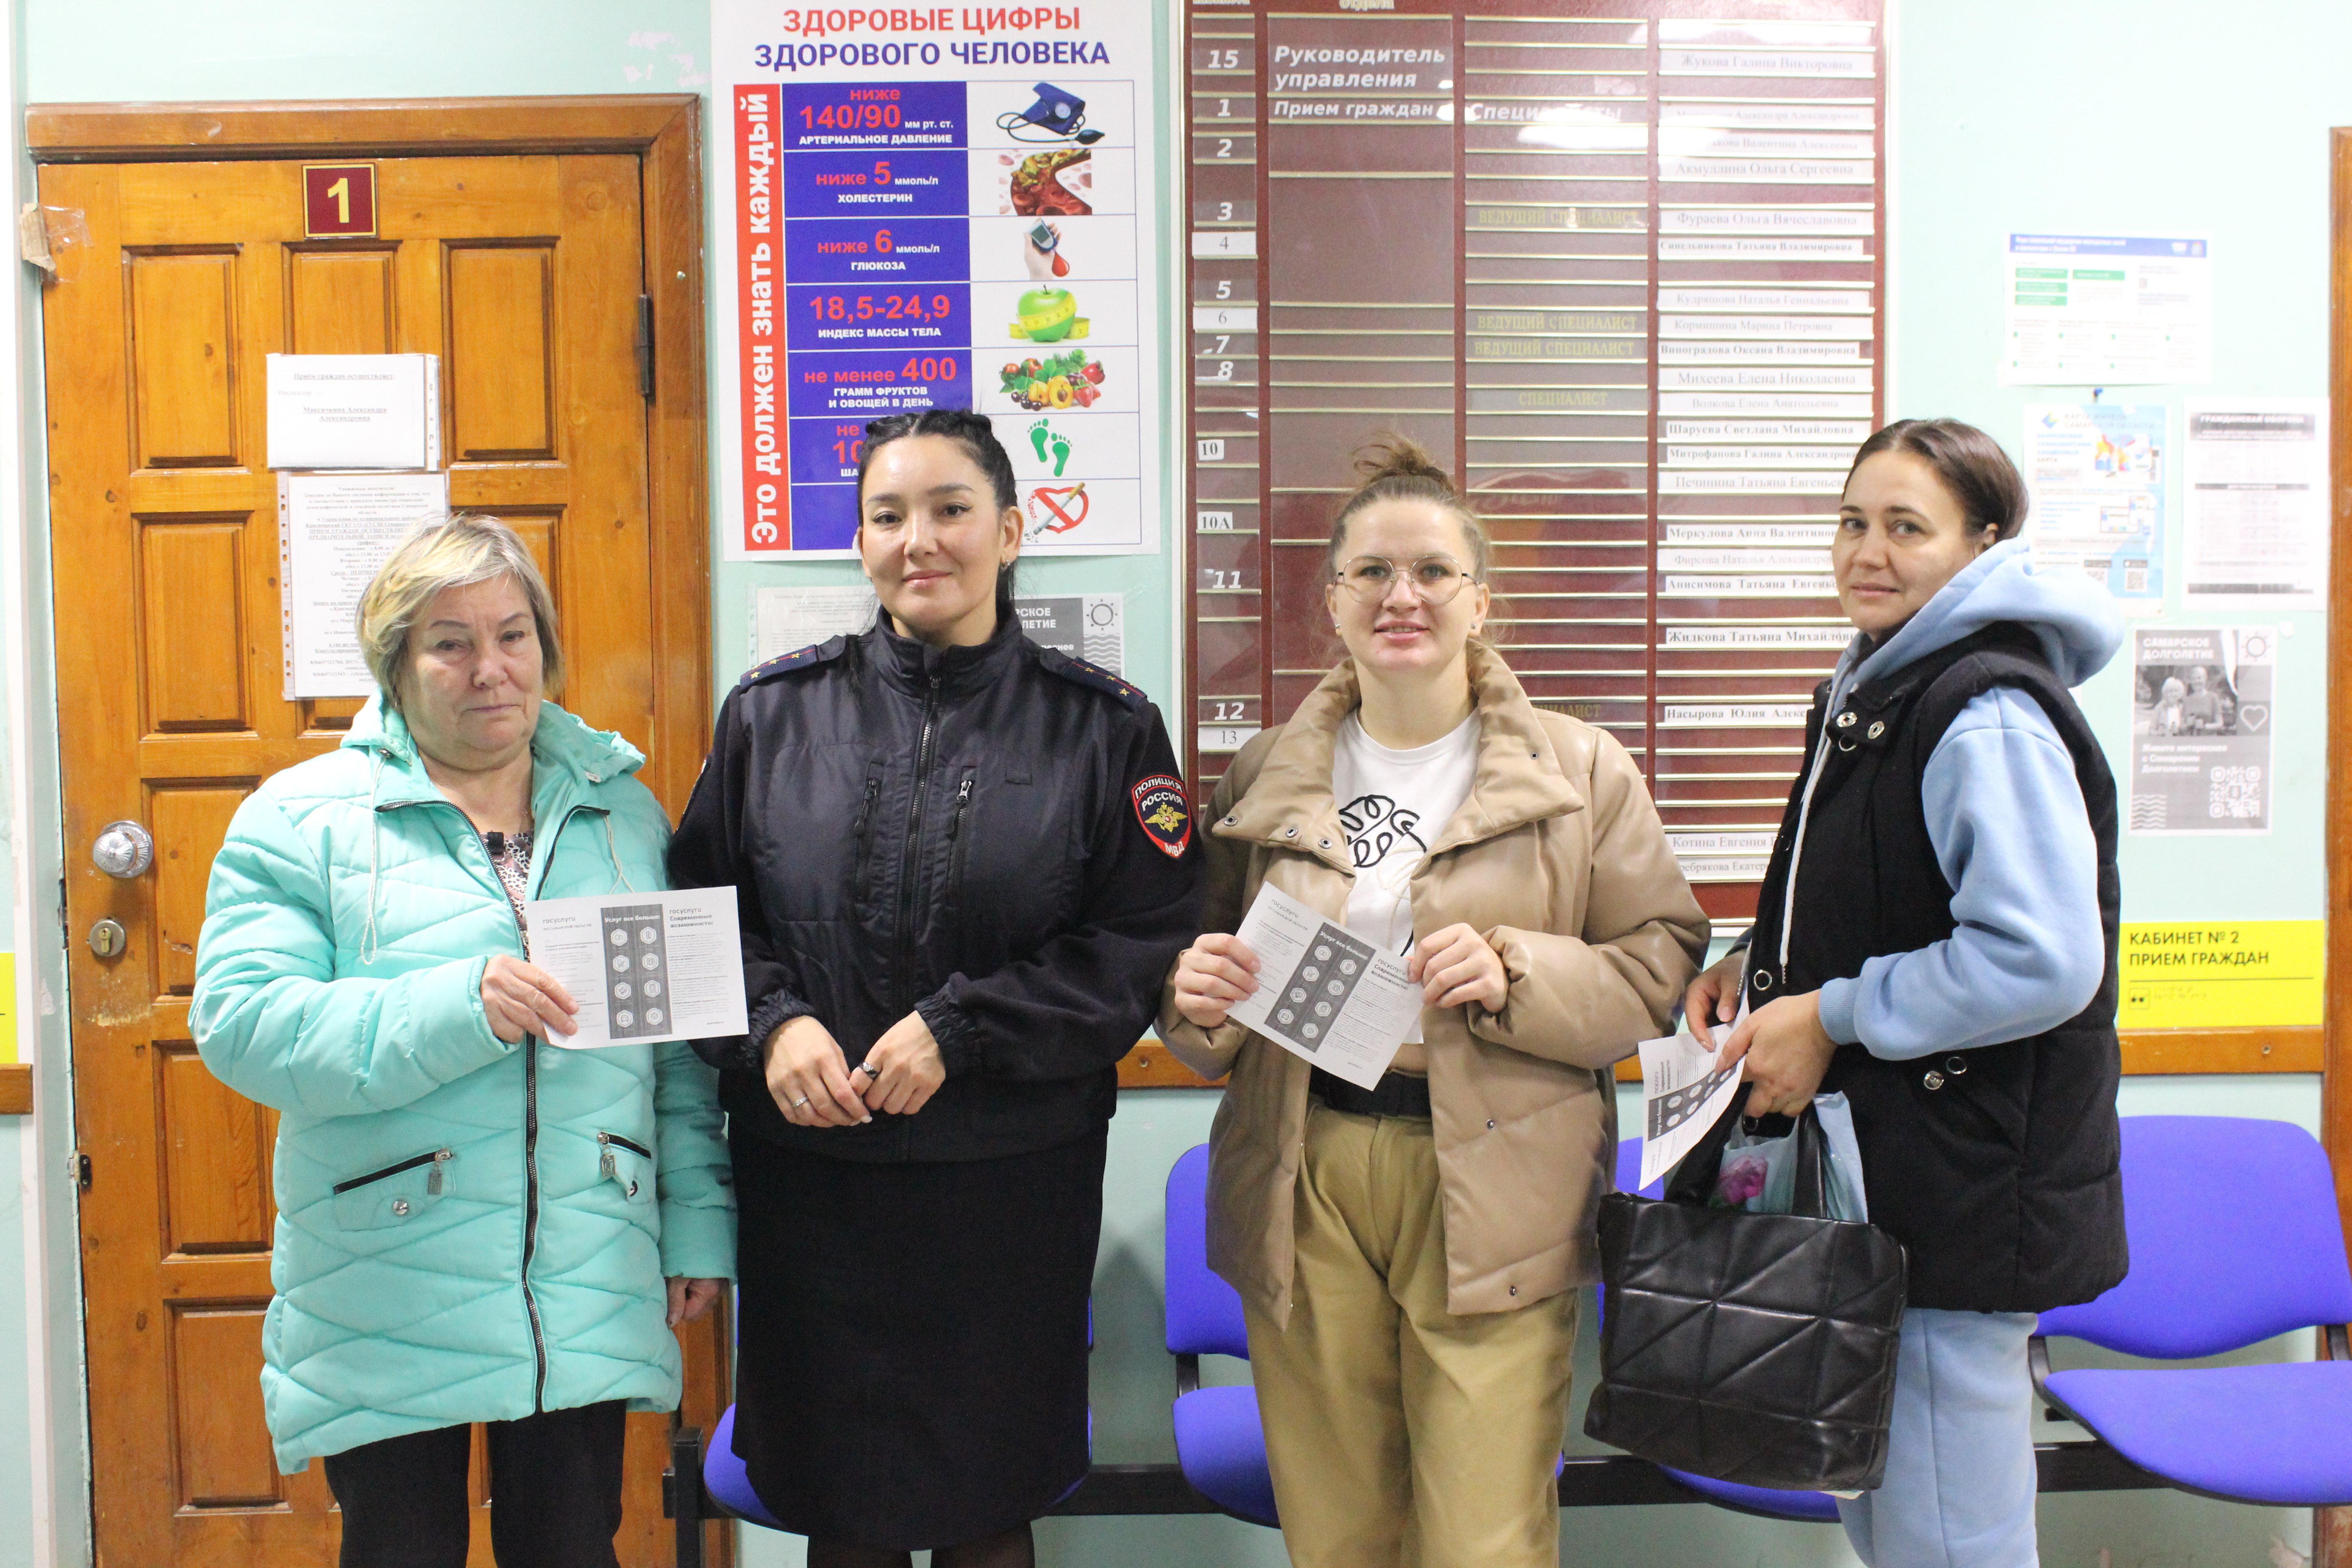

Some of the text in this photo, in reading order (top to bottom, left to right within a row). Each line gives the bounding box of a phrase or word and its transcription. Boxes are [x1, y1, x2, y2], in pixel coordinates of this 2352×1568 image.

[784, 7, 1081, 36] ЗДОРОВЫЕ ЦИФРЫ
[755, 42, 1110, 71] ЗДОРОВОГО ЧЕЛОВЕКА
[1208, 45, 1446, 69] 15 Руководитель
[1681, 54, 1852, 72] Жукова Галина Викторовна
[1274, 72, 1417, 91] управления
[850, 89, 901, 101] ниже
[1217, 98, 1433, 118] 1 Прием граждан
[799, 104, 901, 129] 140/90
[922, 120, 937, 130] рт.
[940, 120, 954, 128] ст.
[799, 134, 952, 146] АРТЕРИАЛЬНОЕ ДАВЛЕНИЕ
[1217, 138, 1232, 157] 2
[1743, 137, 1796, 150] Валентина
[816, 161, 939, 186] ниже 5 ммоль/л
[1676, 162, 1853, 177] Акмуллина Ольга Сергеевна
[327, 177, 350, 223] 1
[838, 193, 913, 203] ХОЛЕСТЕРИН
[1217, 201, 1233, 222] 3
[1479, 209, 1546, 225] ВЕДУЩИЙ
[1733, 213, 1770, 228] Ольга
[1773, 213, 1857, 228] Вячеславовна
[817, 229, 940, 254] ниже 6 ммоль/л
[1219, 236, 1229, 250] 4
[1736, 240, 1776, 252] Татьяна
[851, 261, 906, 271] ГЛЮКОЗА
[1216, 280, 1231, 299] 5
[1739, 294, 1781, 306] Наталья
[809, 295, 950, 324] 18,5-24,9
[740, 93, 781, 544] Это должен знать каждый
[1218, 311, 1227, 324] 6
[1478, 315, 1638, 332] ВЕДУЩИЙ СПЕЦИАЛИСТ
[818, 328, 941, 339] ИНДЕКС МАССЫ ТЕЛА
[1740, 320, 1780, 333] Марина
[1783, 320, 1833, 334] Петровна
[1215, 335, 1230, 354] 7
[1475, 341, 1634, 358] ВЕДУЩИЙ СПЕЦИАЛИСТ
[1661, 344, 1856, 358] Виноградова Оксана Владимировна
[804, 358, 956, 383] не менее 400
[1217, 361, 1234, 380] 8
[1678, 372, 1856, 385] Михеева Елена Николаевна
[833, 385, 927, 396] ГРАММ ФРУКТОВ
[829, 397, 933, 410] И ОВОЩЕЙ В ДЕНЬ
[1519, 392, 1608, 407] СПЕЦИАЛИСТ
[1692, 397, 1839, 411] Волкова Елена Анатольевна
[837, 425, 860, 436] не
[1724, 424, 1779, 436] Светлана
[1782, 424, 1854, 436] Михайловна
[1201, 441, 1219, 456] 10
[1670, 448, 1782, 462] Митрофанова Галина
[1738, 476, 1786, 489] Татьяна
[1669, 527, 1734, 541] Меркулова
[1736, 527, 1766, 539] Анна
[1674, 553, 1764, 568] Фирсова Наталья
[1212, 570, 1242, 589] 11
[1667, 578, 1785, 590] Анисимова Татьяна
[1022, 619, 1056, 629] ЛЕТИЕ
[1668, 631, 1782, 645] Жидкова Татьяна
[2143, 637, 2210, 647] САМАРСКОЕ
[2143, 649, 2214, 661] ДОЛГОЛЕТИЕ
[1214, 701, 1245, 721] 12
[1667, 708, 1765, 720] Насырова Юлия
[1220, 730, 1237, 745] 13
[1135, 778, 1183, 799] ПОЛИЦИЯ
[1141, 792, 1184, 811] РОССИЯ
[1164, 841, 1185, 856] МВД
[1673, 837, 1715, 848] Котина
[1719, 837, 1766, 848] Евгения
[1319, 930, 1336, 942] Услуг
[1346, 943, 1369, 961] больше:
[2130, 931, 2239, 945] КАБИНЕТ № 2
[2130, 951, 2269, 966] ПРИЕМ ГРАЖДАН
